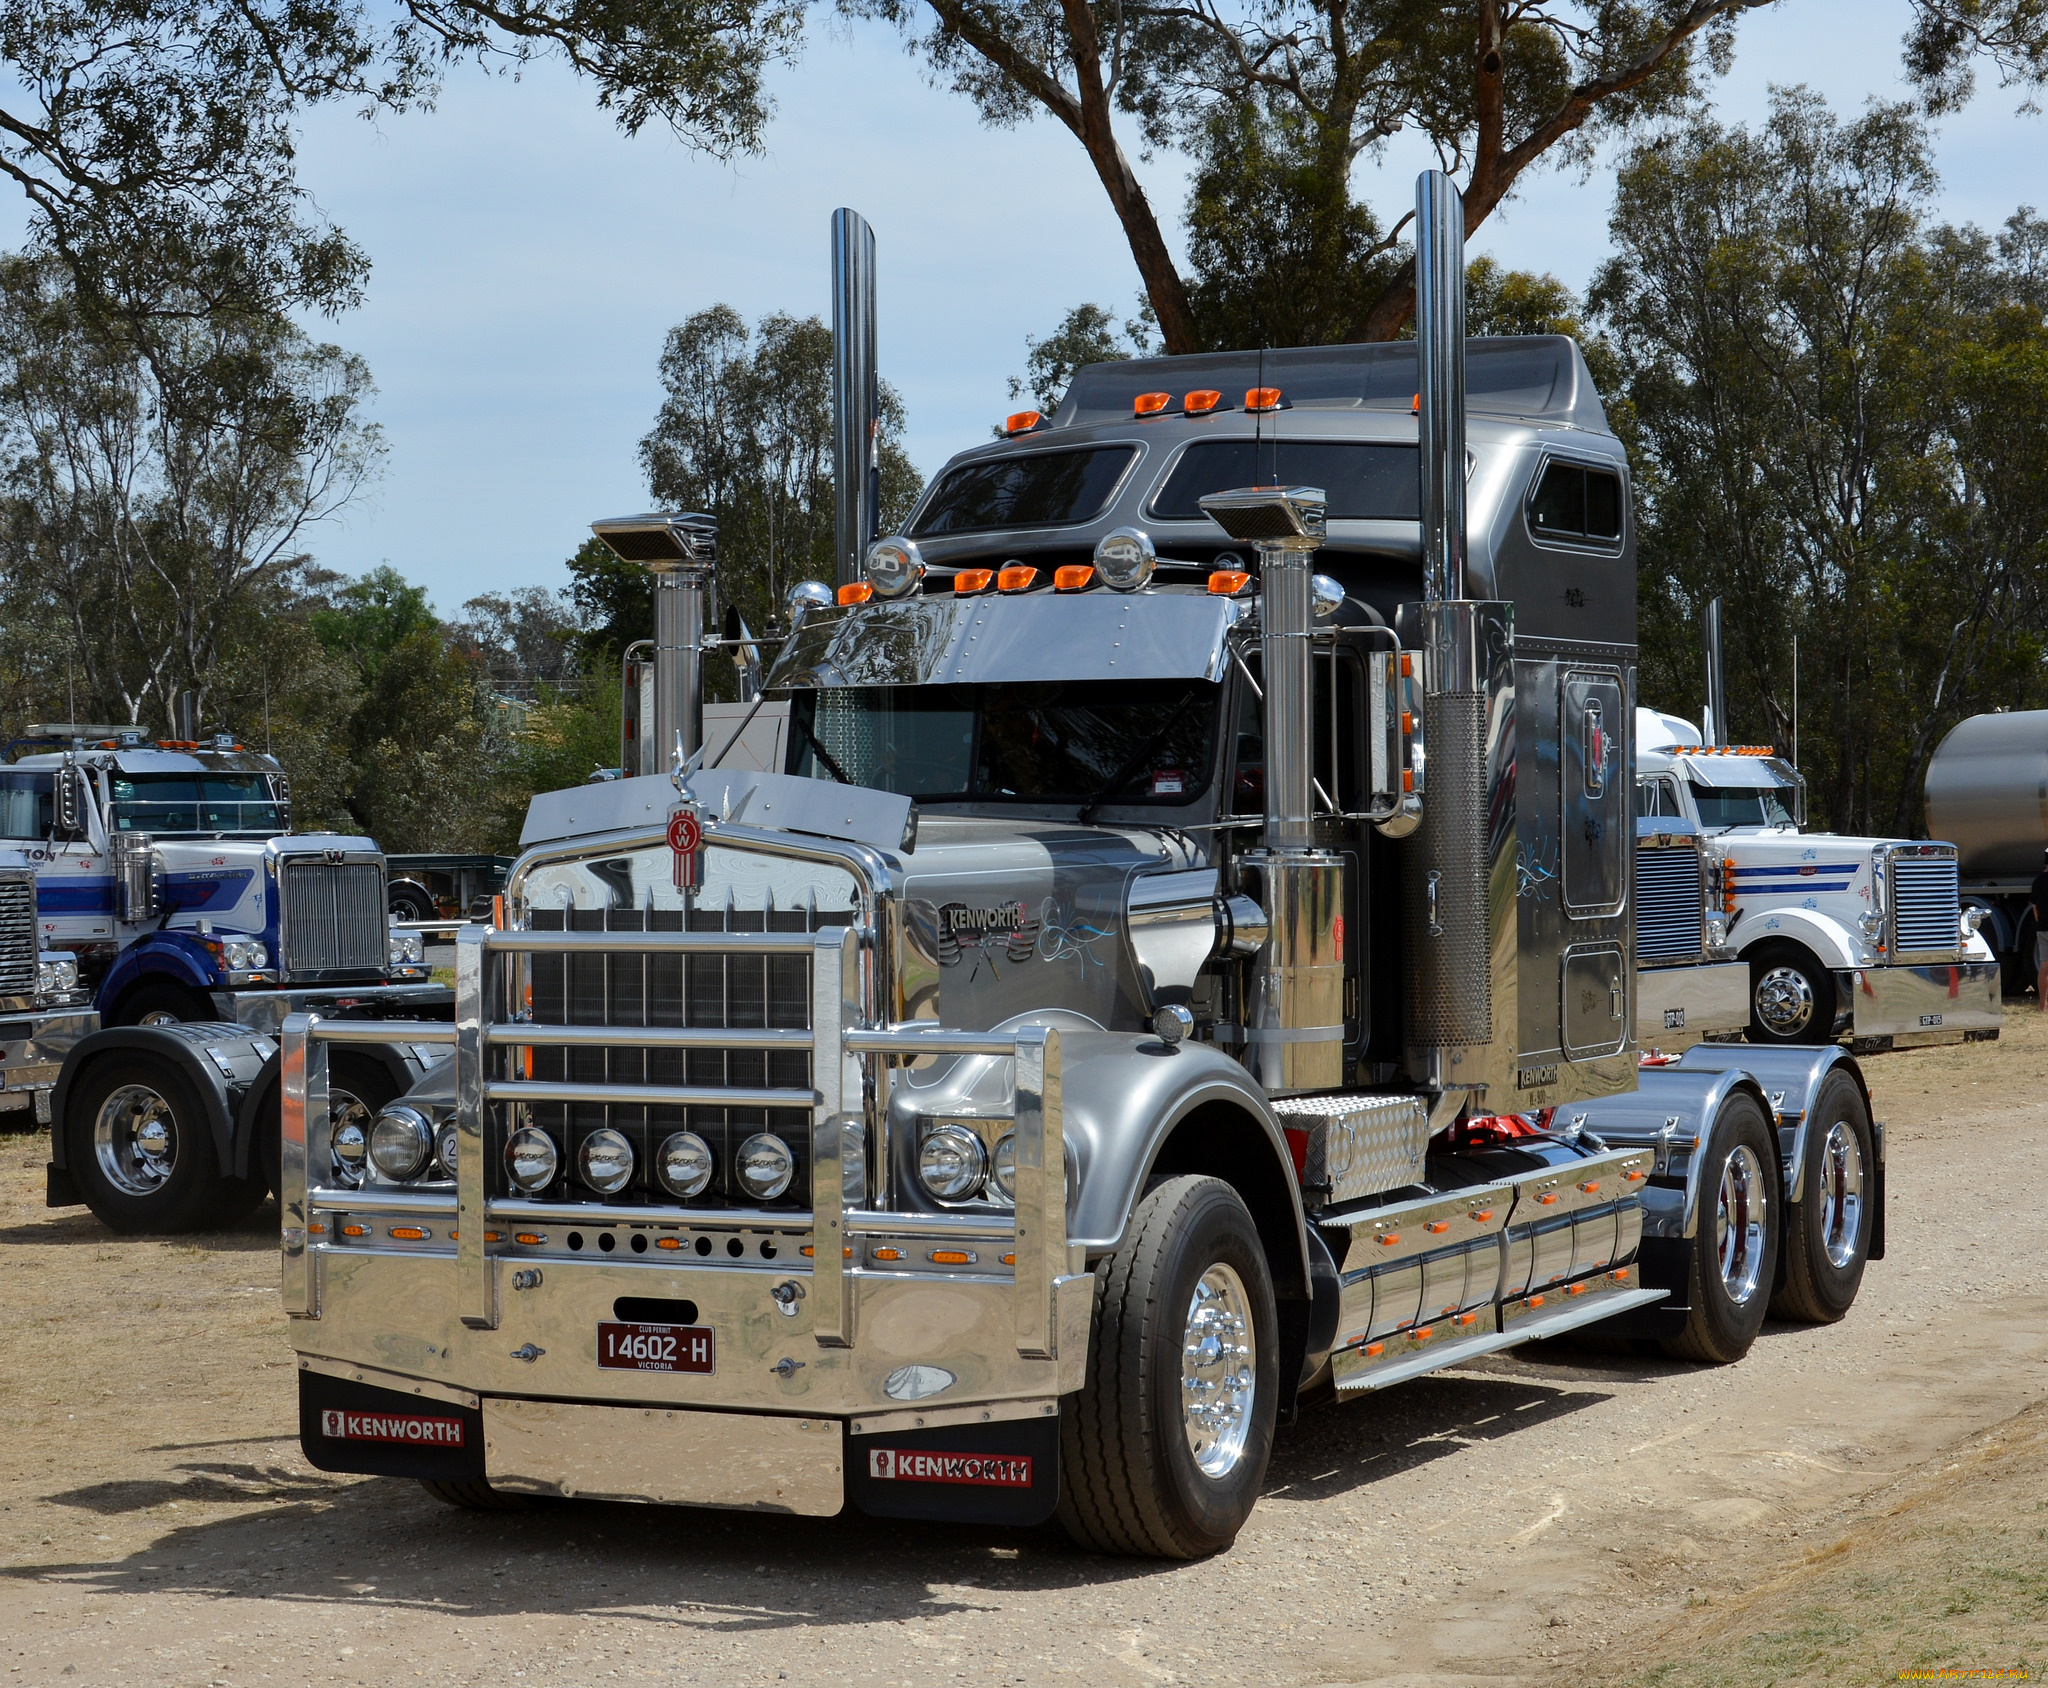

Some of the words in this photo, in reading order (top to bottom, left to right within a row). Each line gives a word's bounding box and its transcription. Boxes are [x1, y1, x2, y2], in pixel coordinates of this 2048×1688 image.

[949, 907, 1021, 929] KENWORTH
[1521, 1065, 1558, 1087] KENWORTH
[639, 1325, 652, 1333] CLUB
[652, 1326, 671, 1334] PERMIT
[638, 1361, 673, 1370] VICTORIA
[348, 1416, 460, 1442] KENWORTH
[899, 1455, 1027, 1482] KENWORTH
